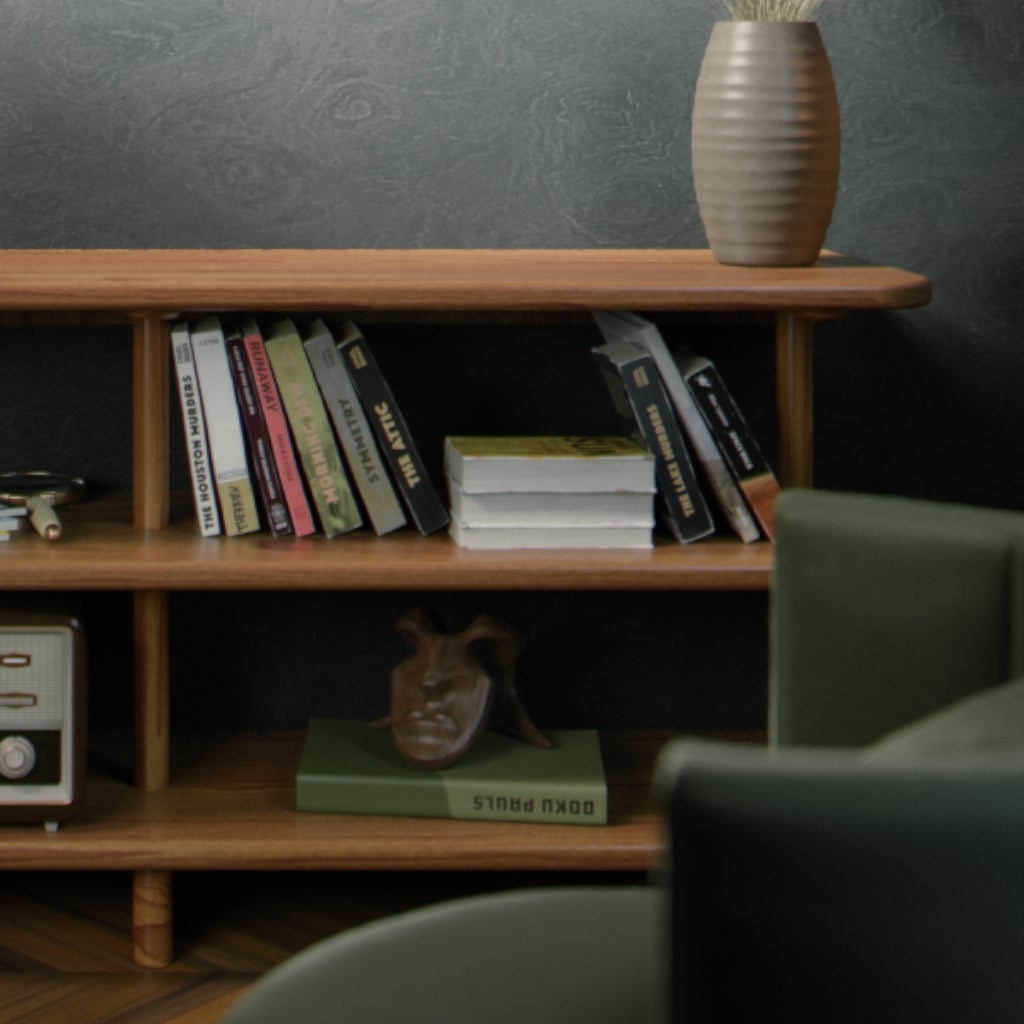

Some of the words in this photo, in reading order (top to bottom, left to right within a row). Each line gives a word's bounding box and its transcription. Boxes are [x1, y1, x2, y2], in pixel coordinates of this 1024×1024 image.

[249, 341, 278, 413] RUNAWAY
[183, 375, 200, 436] MURDERS
[289, 381, 309, 420] DEW
[339, 399, 380, 485] SYMMETRY
[374, 401, 405, 451] ATTIC
[646, 403, 676, 461] MURDERS
[193, 444, 211, 503] HOUSTON
[305, 421, 338, 504] MORNING
[397, 455, 421, 489] THE
[667, 461, 686, 494] LAKE
[204, 506, 215, 531] THE
[678, 493, 695, 519] THE
[472, 795, 535, 813] PAULS
[541, 797, 595, 816] DOKU
